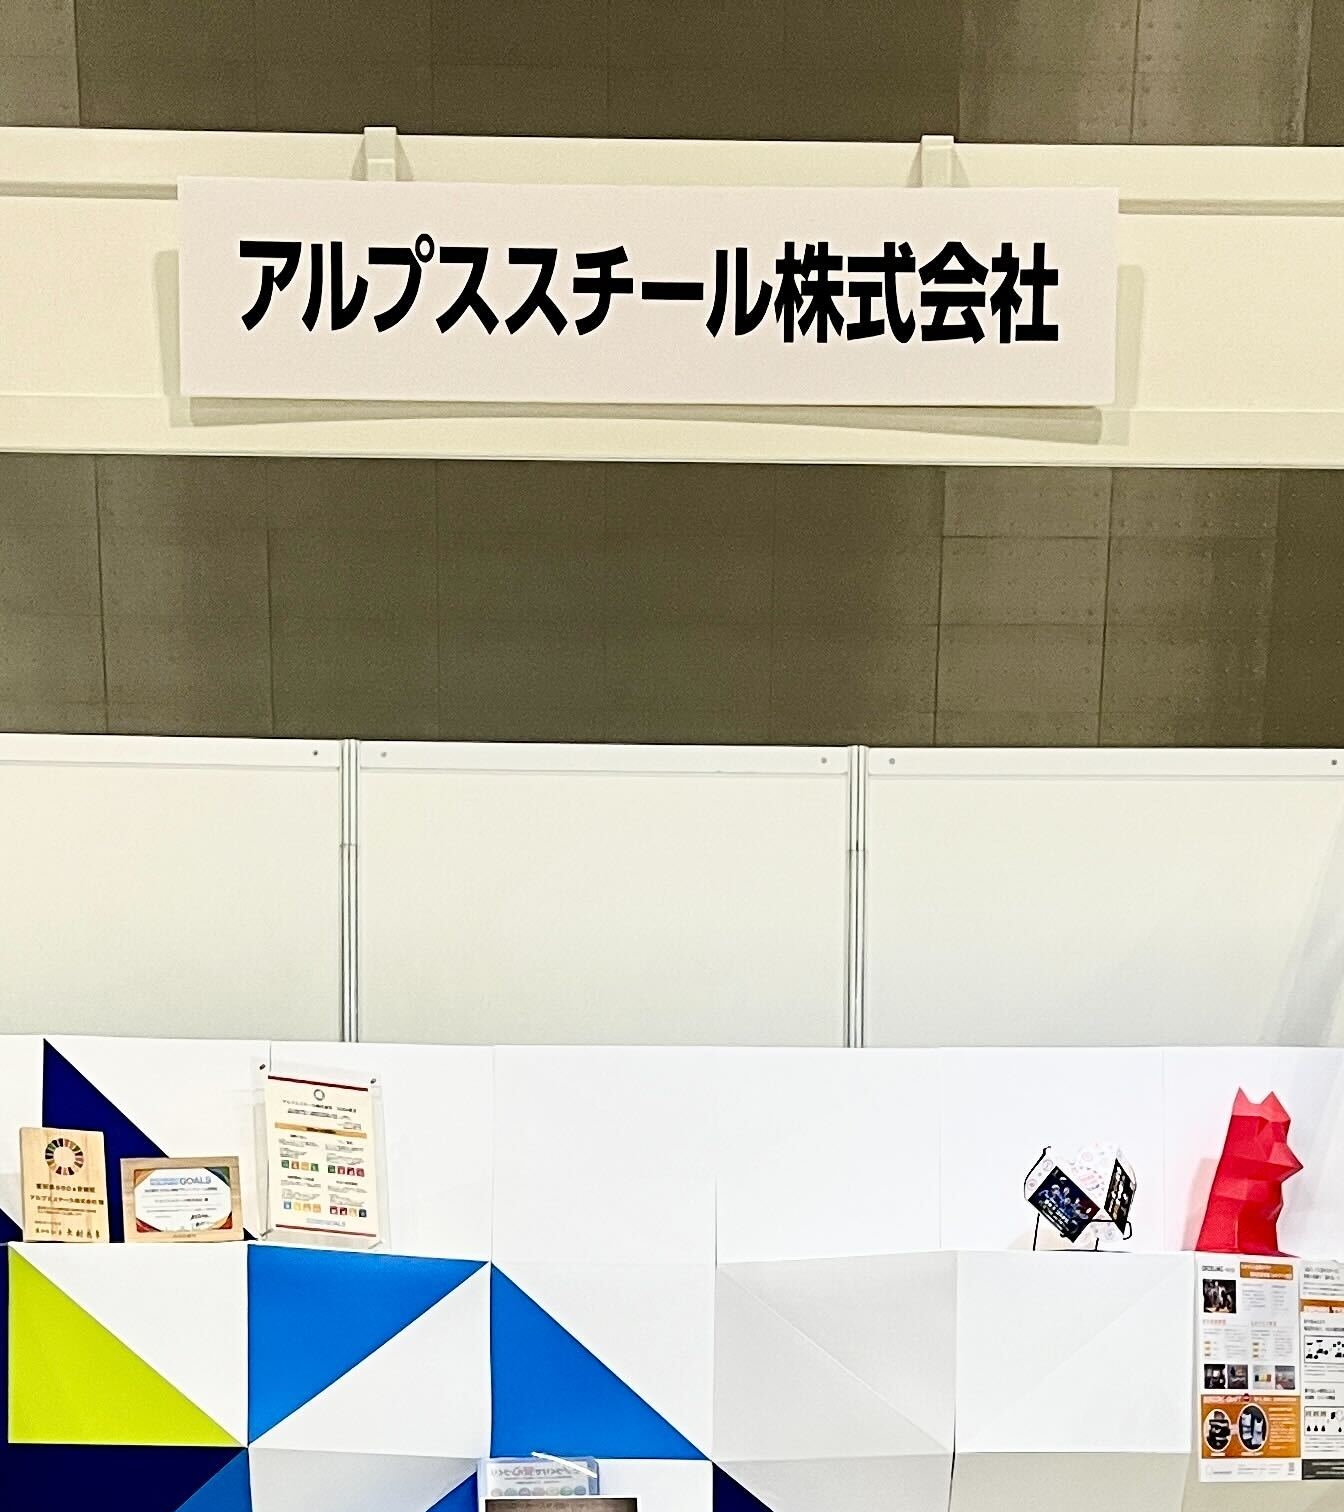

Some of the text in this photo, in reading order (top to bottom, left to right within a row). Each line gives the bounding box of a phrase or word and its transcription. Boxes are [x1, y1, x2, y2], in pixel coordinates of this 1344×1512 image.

[238, 233, 1060, 344] アルプススチール株式会社
